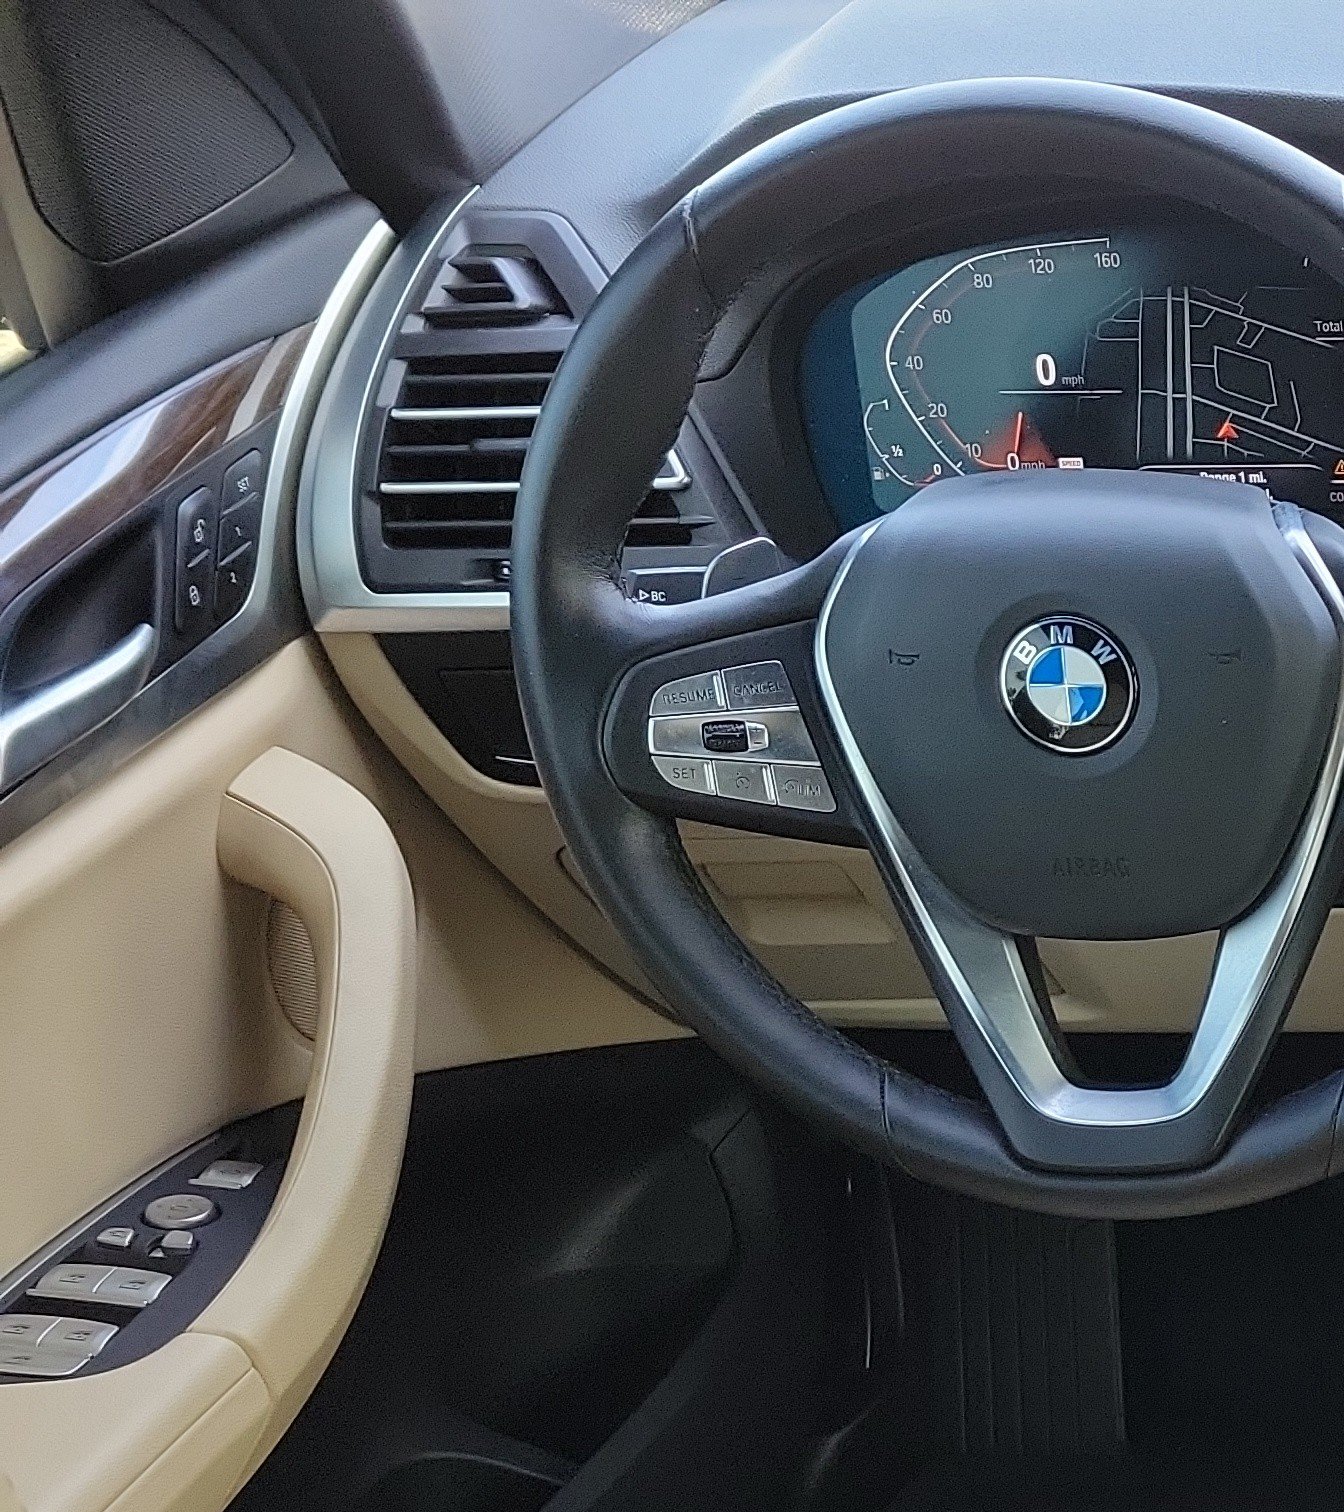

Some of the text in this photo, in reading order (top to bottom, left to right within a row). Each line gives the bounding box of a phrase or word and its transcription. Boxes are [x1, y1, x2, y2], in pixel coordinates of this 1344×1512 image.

[1028, 258, 1055, 275] 120
[1094, 252, 1121, 269] 160
[973, 273, 993, 289] 80
[932, 309, 952, 325] 60
[1313, 320, 1344, 332] Total
[904, 355, 924, 371] 40
[1036, 353, 1085, 388] 0 mph
[928, 403, 948, 418] 20
[965, 443, 982, 458] 10
[933, 463, 942, 476] 0
[1007, 452, 1020, 471] 0
[651, 591, 667, 601] BC
[1013, 624, 1118, 666] BMW
[662, 688, 716, 705] RESUME
[733, 681, 782, 697] CANCEL
[672, 767, 696, 779] SET
